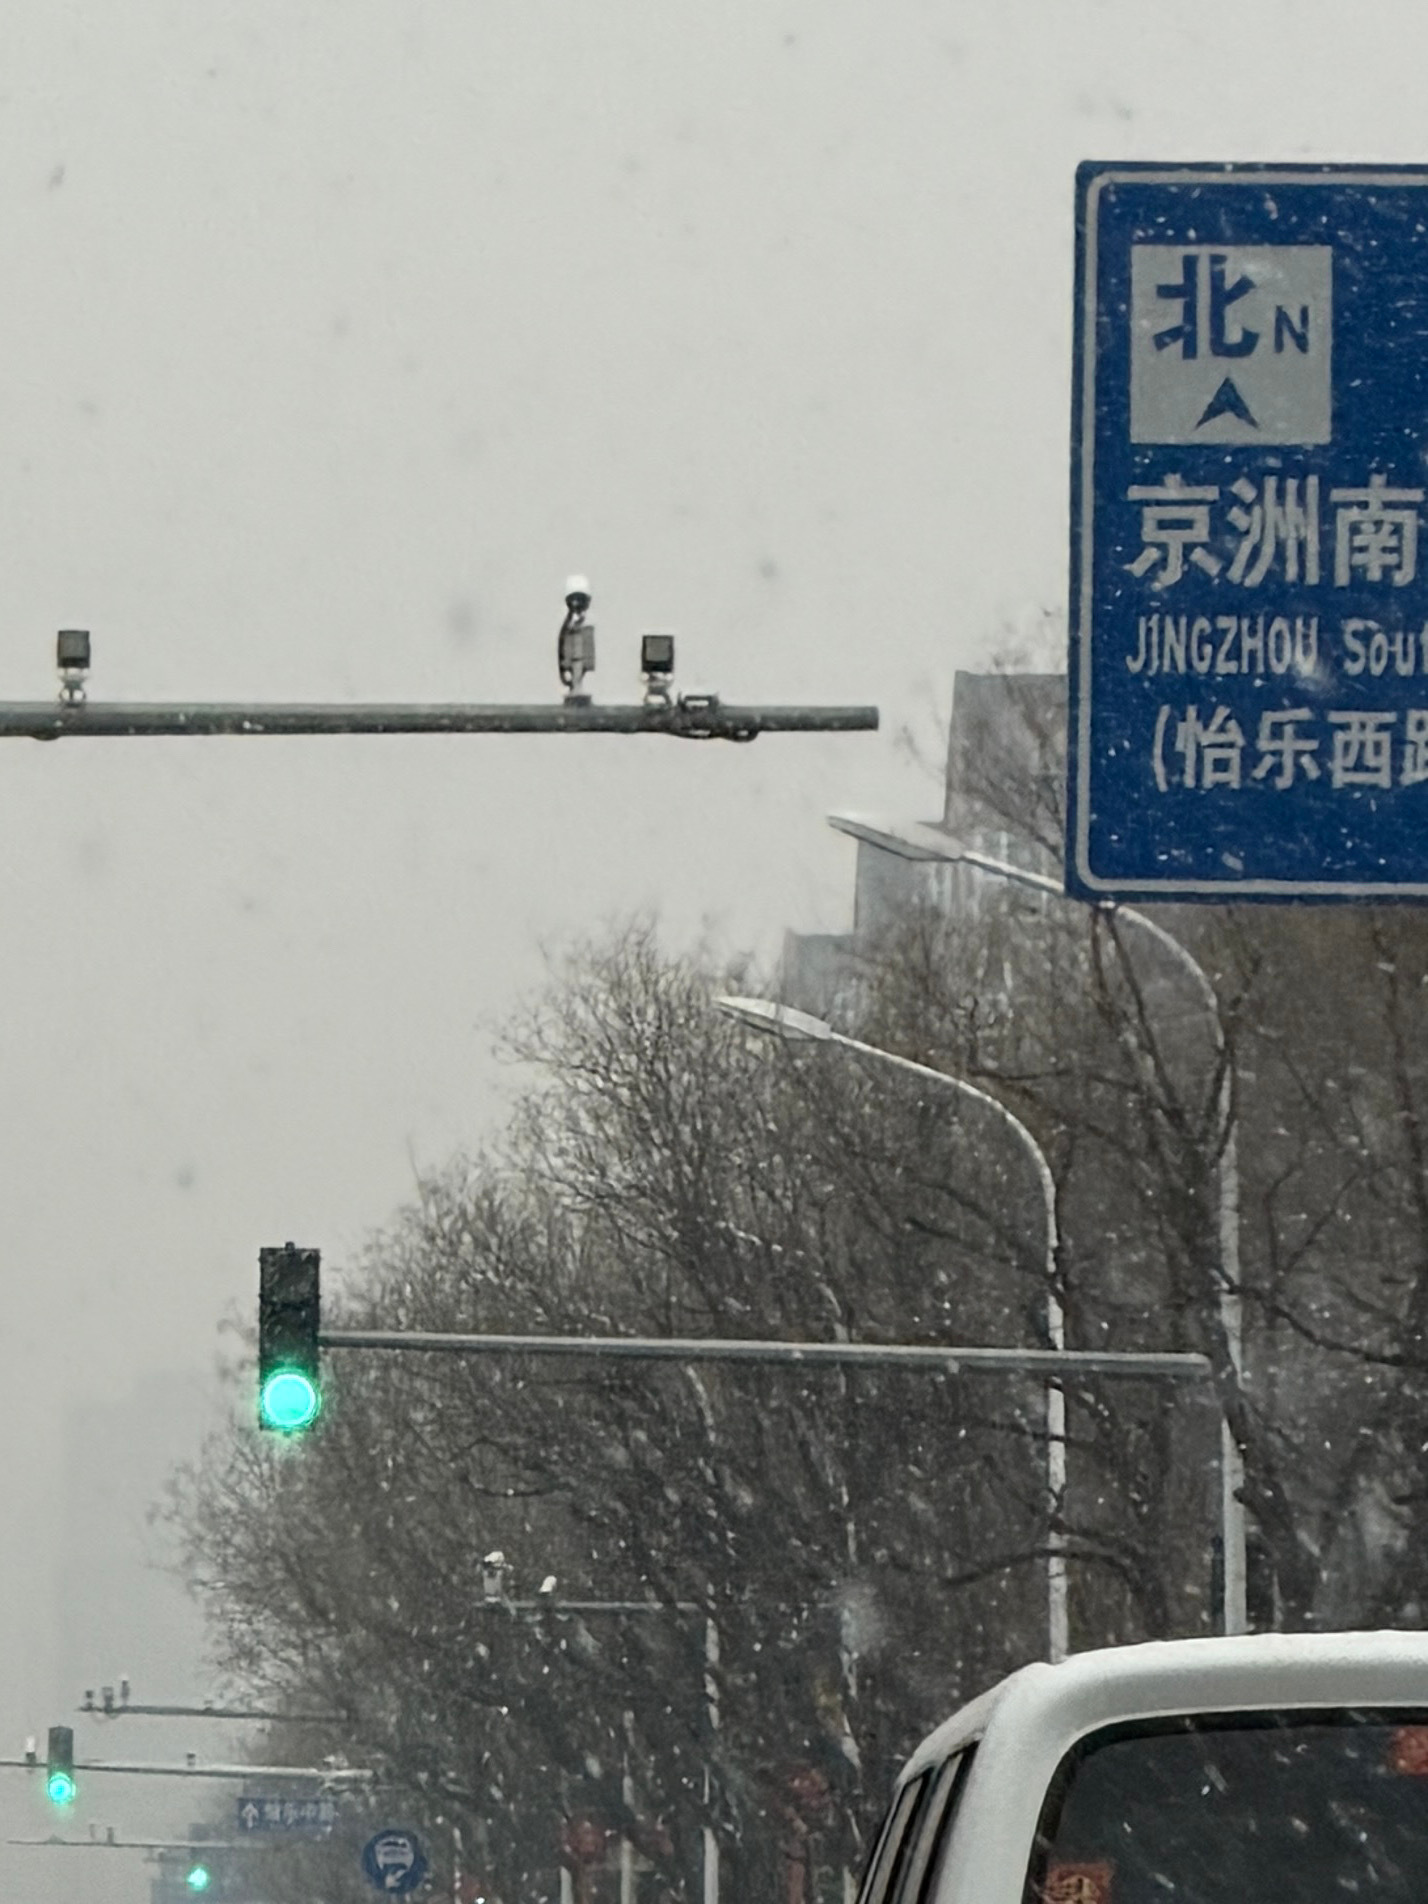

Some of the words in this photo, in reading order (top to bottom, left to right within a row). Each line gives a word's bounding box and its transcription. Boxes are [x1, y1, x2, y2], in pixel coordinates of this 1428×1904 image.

[1153, 253, 1261, 361] 北
[1274, 304, 1309, 356] N
[1124, 472, 1425, 592] 京洲南
[1126, 613, 1319, 676] JINGZHOU
